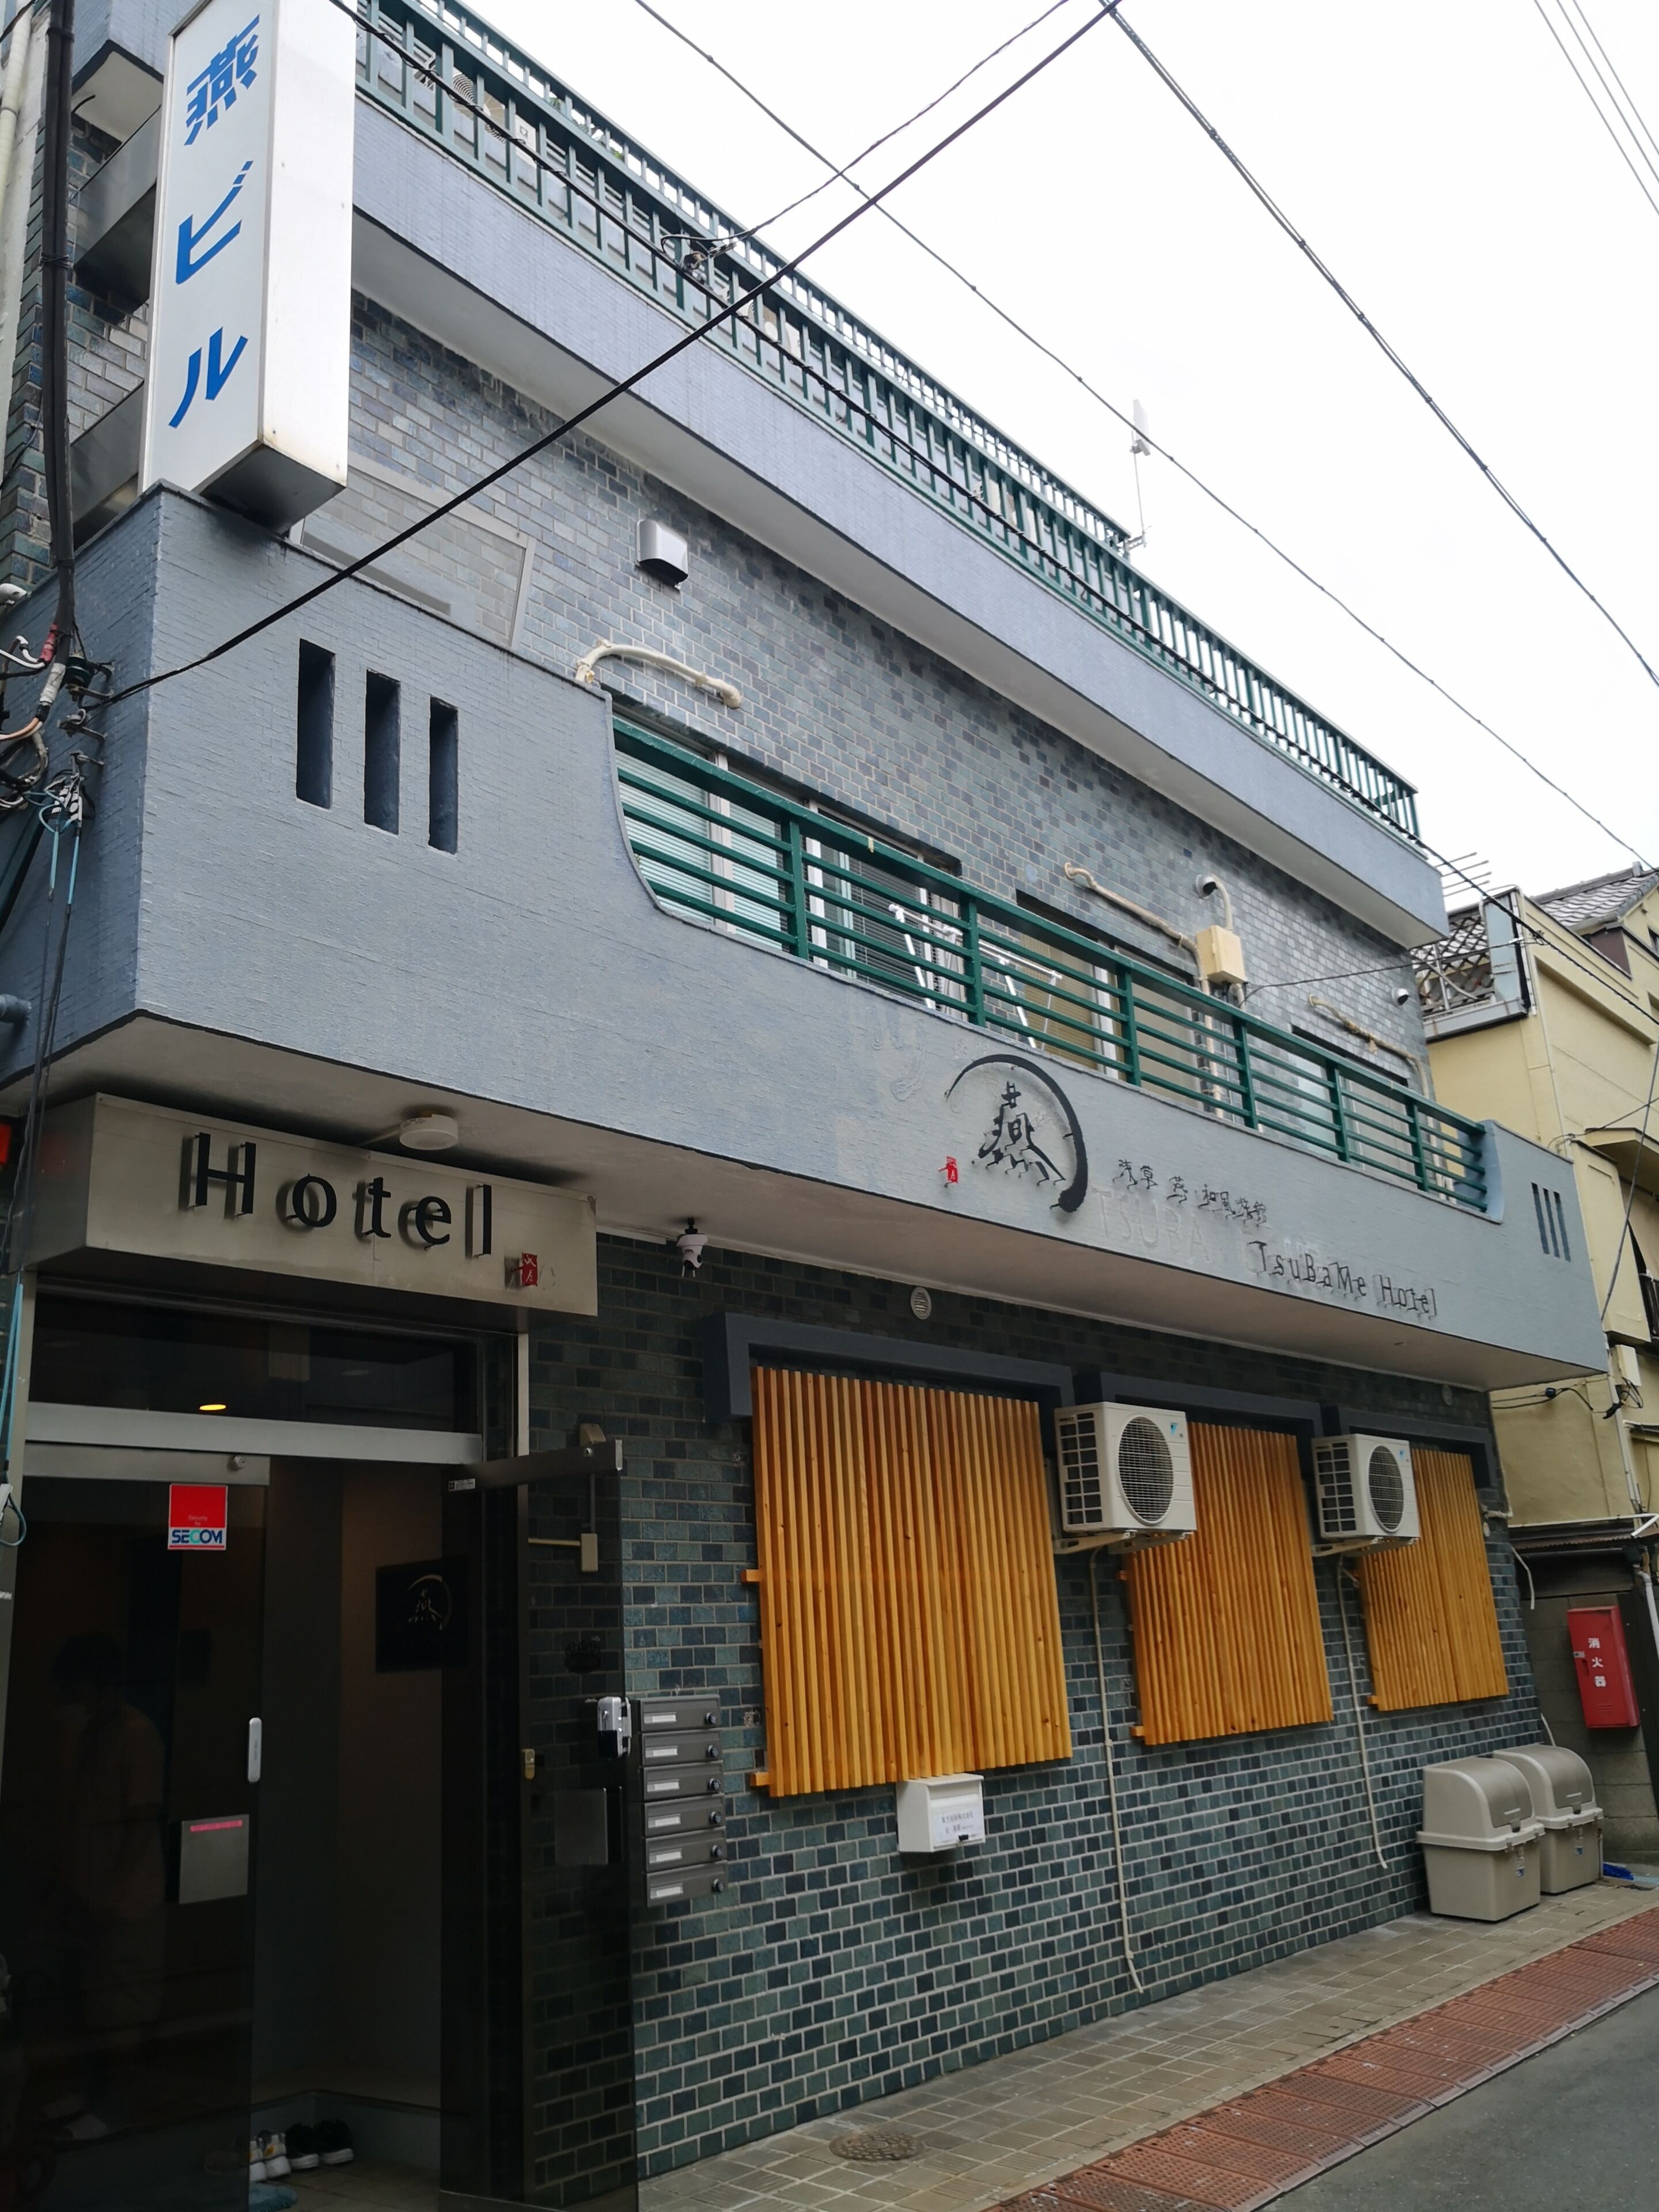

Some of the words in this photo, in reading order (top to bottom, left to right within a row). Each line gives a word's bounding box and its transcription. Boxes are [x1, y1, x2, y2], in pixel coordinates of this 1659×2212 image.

[168, 14, 261, 429] 燕ビル
[195, 1131, 493, 1255] Hotel
[1378, 1274, 1437, 1317] Hotel
[171, 1529, 223, 1544] SECOM
[1588, 1637, 1607, 1687] 消火器
